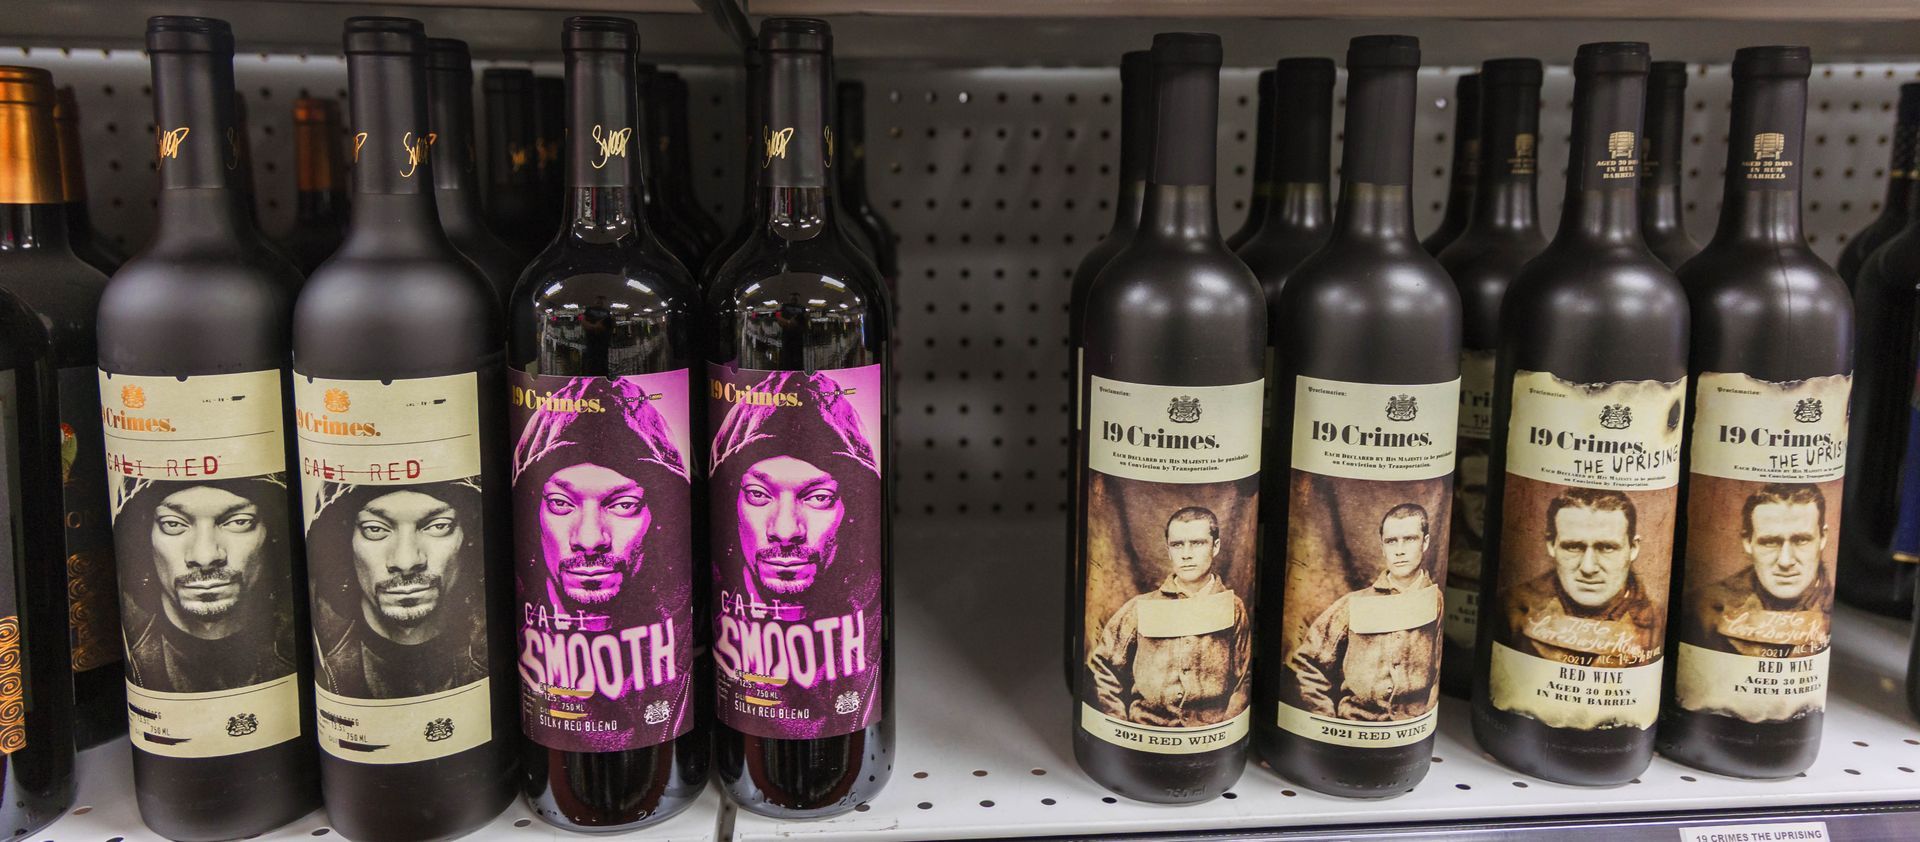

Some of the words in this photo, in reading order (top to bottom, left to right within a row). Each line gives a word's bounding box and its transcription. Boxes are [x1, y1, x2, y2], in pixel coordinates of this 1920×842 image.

[525, 388, 606, 413] Crimes.
[724, 382, 803, 407] Crimes.
[107, 407, 176, 432] Crimes.
[304, 412, 381, 437] Crimes.
[1102, 420, 1123, 443] 19
[1127, 424, 1220, 450] Crimes.
[1312, 420, 1337, 442] 19
[1341, 424, 1433, 447] Crimes.
[1529, 426, 1553, 447] 19
[1557, 430, 1647, 455] Crimes.
[1719, 425, 1746, 444] 19
[1751, 427, 1834, 448] Crimes.
[107, 452, 143, 477] CALI
[166, 455, 219, 477] RED
[1112, 451, 1126, 459] EACH
[1127, 453, 1158, 463] DECLARED
[1324, 451, 1340, 459] EACH
[1342, 453, 1374, 461] DECLARED
[1342, 460, 1376, 468] Conviction
[1769, 453, 1799, 469] THE
[304, 457, 345, 481] CALI
[370, 459, 421, 481] RED
[1128, 461, 1160, 471] Conviction
[1574, 459, 1604, 474] THE
[720, 590, 783, 620] CALI
[525, 602, 588, 631] CALI
[517, 617, 676, 700] SMOOTH
[712, 609, 866, 690] SMOOTH
[1560, 666, 1586, 682] RED
[1593, 671, 1624, 684] WINE
[1758, 660, 1784, 674] RED
[1789, 658, 1815, 672] WINE
[1546, 680, 1581, 694] AGED
[1605, 688, 1632, 697] DAYS
[1734, 685, 1748, 693] IN
[1753, 687, 1779, 695] RUM
[1784, 683, 1822, 695] BARRELS
[1745, 675, 1778, 686] AGED
[1783, 678, 1795, 686] 30
[1799, 675, 1819, 685] DAYS
[1536, 688, 1549, 698] IN
[1555, 693, 1581, 704] RUM
[1587, 697, 1637, 706] BARRELS
[734, 700, 756, 715] SILKY
[758, 706, 775, 718] RED
[778, 708, 810, 719] BLEND
[540, 714, 562, 729] SILKY
[564, 719, 582, 732] RED
[585, 720, 618, 732] BLEND
[1321, 725, 1353, 739] 2021
[1357, 731, 1391, 741] RED
[1396, 723, 1427, 739] WINE
[1114, 728, 1143, 743] 2021
[1148, 735, 1183, 746] RED
[1188, 731, 1226, 745] WINE
[1710, 833, 1749, 842] CRIMES
[1751, 831, 1771, 841] THE
[1774, 830, 1822, 840] UPRISING
